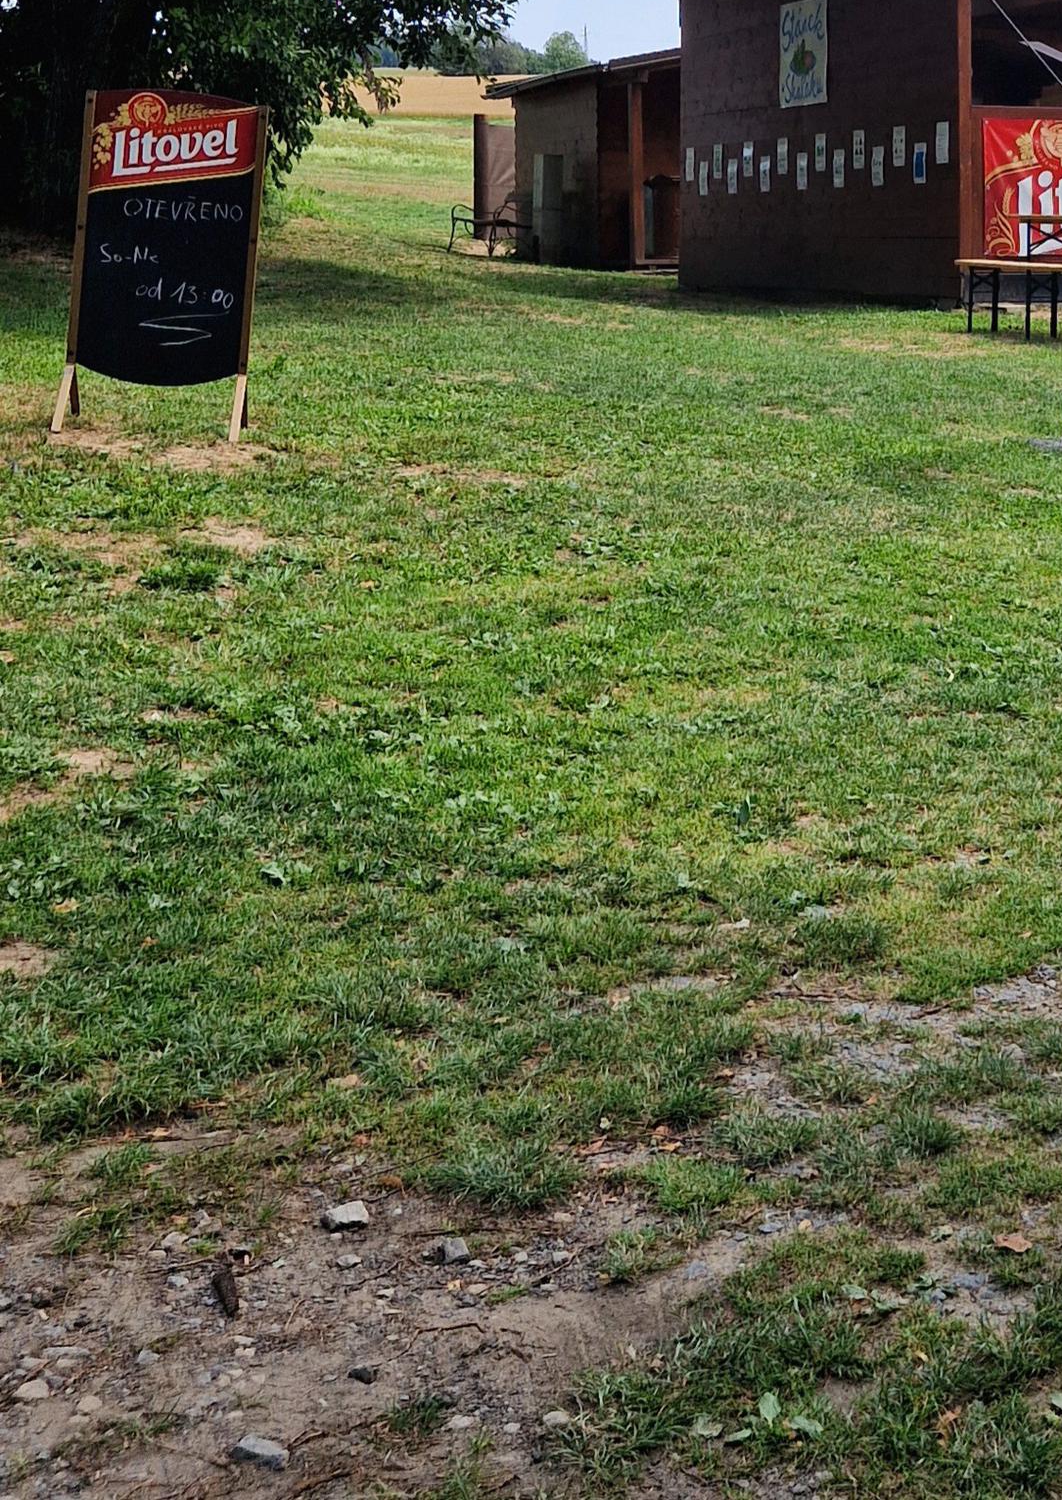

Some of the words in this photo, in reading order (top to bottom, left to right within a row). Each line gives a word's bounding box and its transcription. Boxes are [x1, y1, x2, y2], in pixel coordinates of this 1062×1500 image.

[112, 119, 239, 177] Litovel
[123, 195, 244, 222] OTEVŘENO
[135, 277, 163, 301] od
